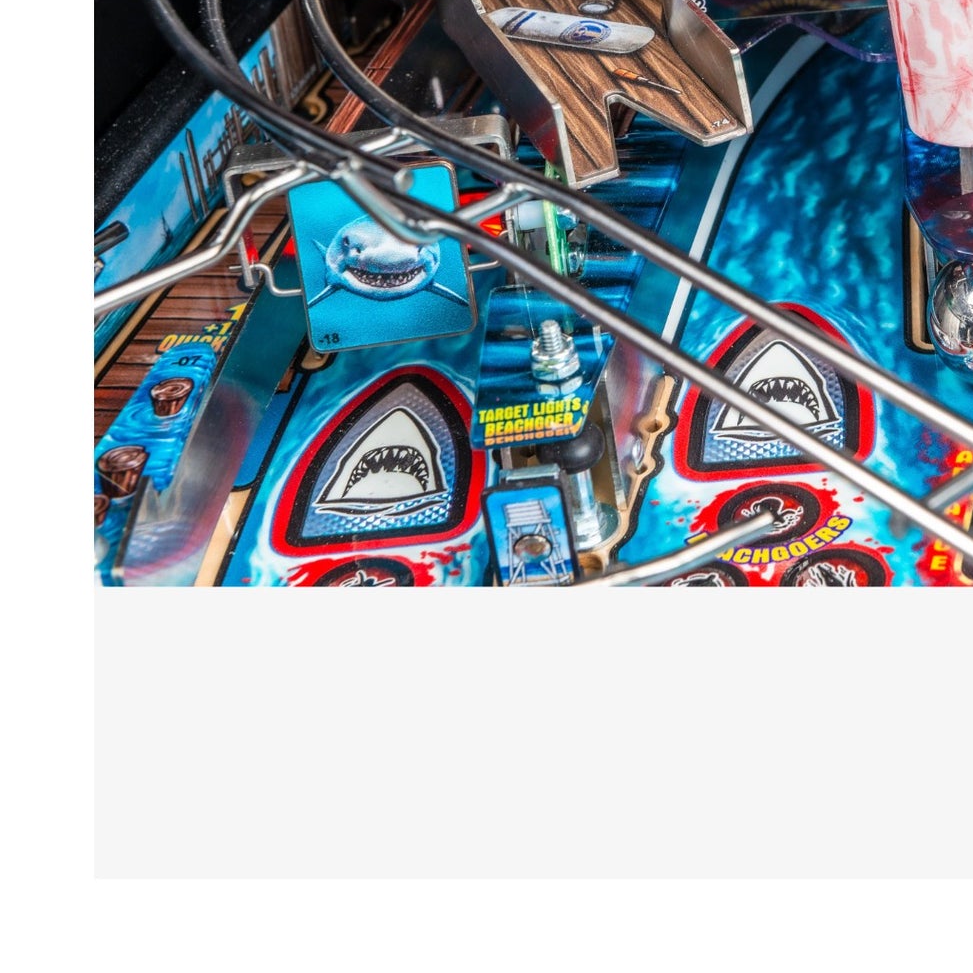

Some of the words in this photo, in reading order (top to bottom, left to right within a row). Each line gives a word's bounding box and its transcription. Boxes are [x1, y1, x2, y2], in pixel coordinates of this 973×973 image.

[318, 332, 341, 346] -18
[171, 355, 204, 367] -07
[478, 403, 530, 424] TARGET
[532, 397, 582, 417] LIGHTS
[484, 412, 574, 438] BEACHGOER
[687, 515, 853, 565] ACHGOERS
